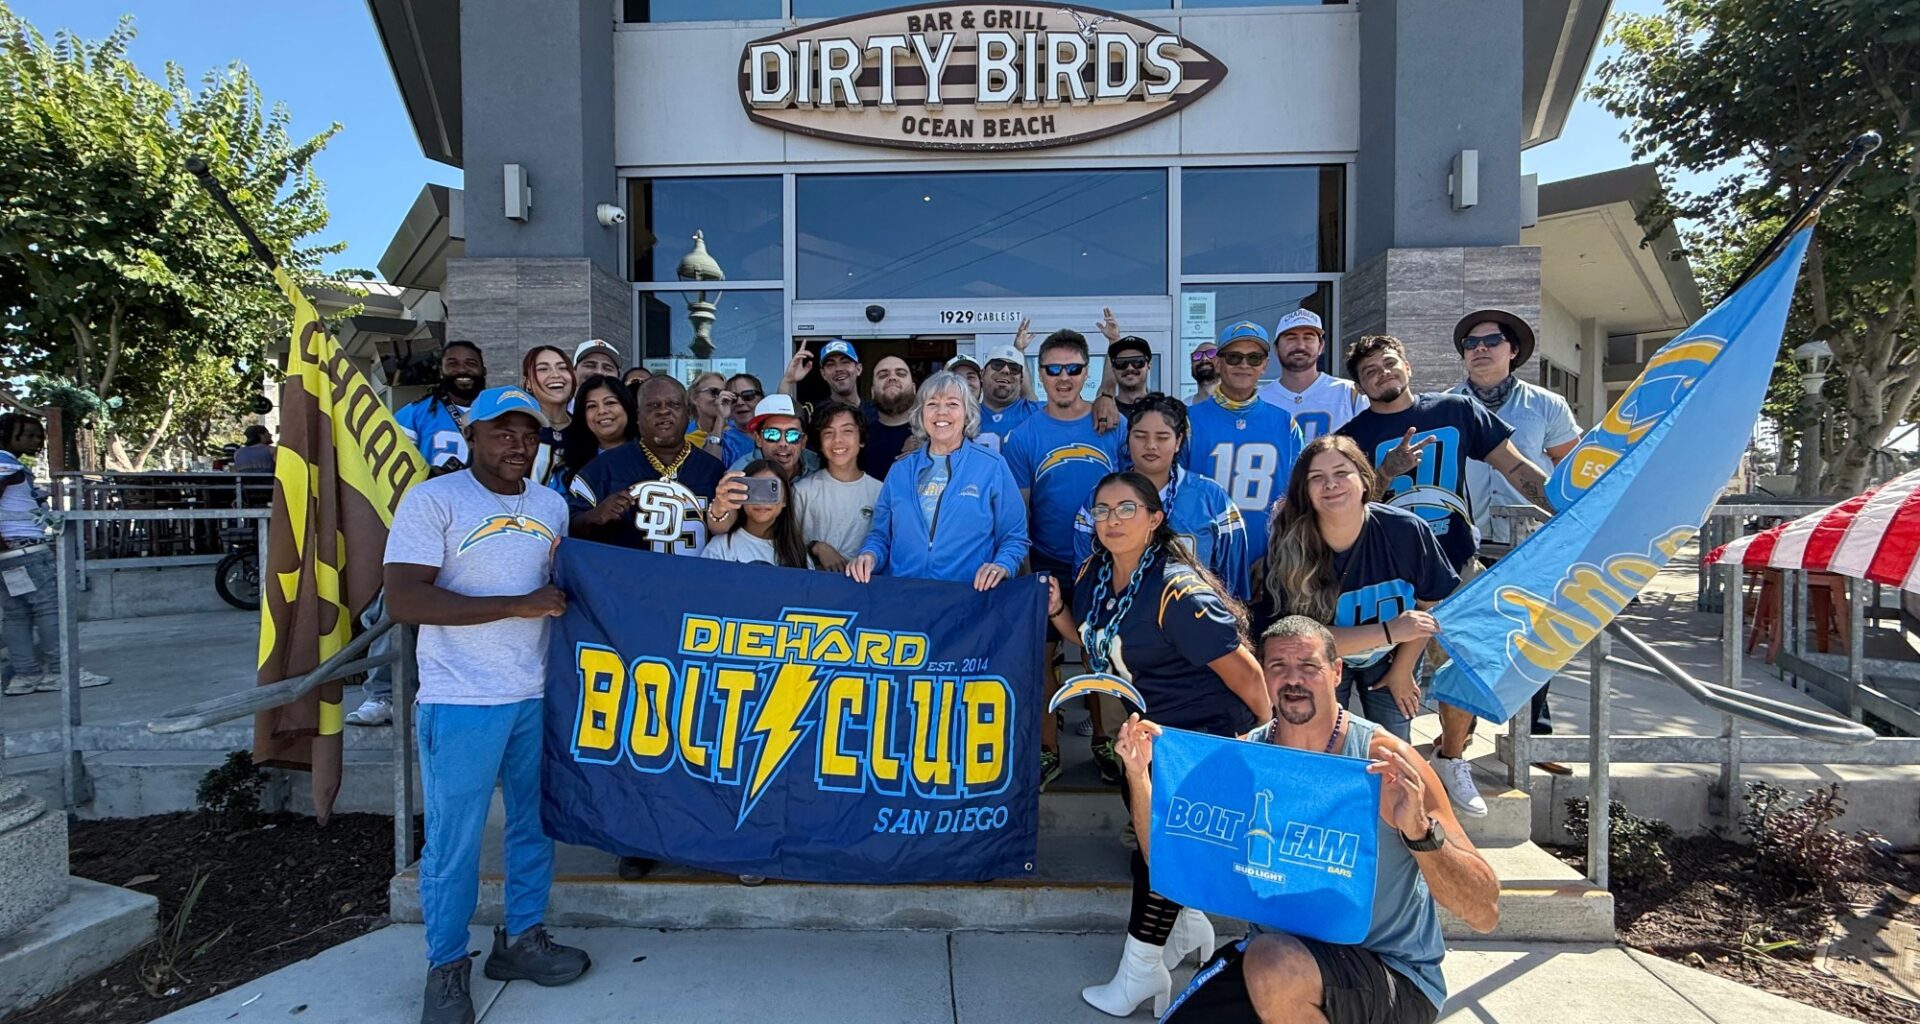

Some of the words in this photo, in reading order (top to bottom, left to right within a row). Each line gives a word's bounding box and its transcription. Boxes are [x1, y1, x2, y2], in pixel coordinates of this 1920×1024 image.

[907, 13, 957, 33] BAR
[962, 11, 976, 29] &
[983, 11, 1047, 31] GRILL
[750, 32, 957, 110] DIRTY
[976, 31, 1184, 110] BIRDS
[901, 115, 974, 138] OCEAN
[983, 115, 1056, 137] BEACH
[940, 310, 974, 324] 1929
[977, 312, 1006, 322] CABLE
[1010, 311, 1021, 321] ST
[1209, 443, 1278, 511] 18
[680, 609, 930, 669] DIEHARD
[926, 659, 958, 673] EST.
[962, 658, 989, 673] 2014
[573, 644, 760, 781] BOLT
[817, 675, 1013, 797] CLUB
[874, 808, 928, 835] SAN
[934, 806, 1009, 834] DIEGO
[1166, 796, 1245, 841] BOLT
[1280, 821, 1360, 868] FAM
[1235, 864, 1256, 875] BUD
[1256, 869, 1283, 882] LIGHT
[1327, 866, 1353, 878] BARS
